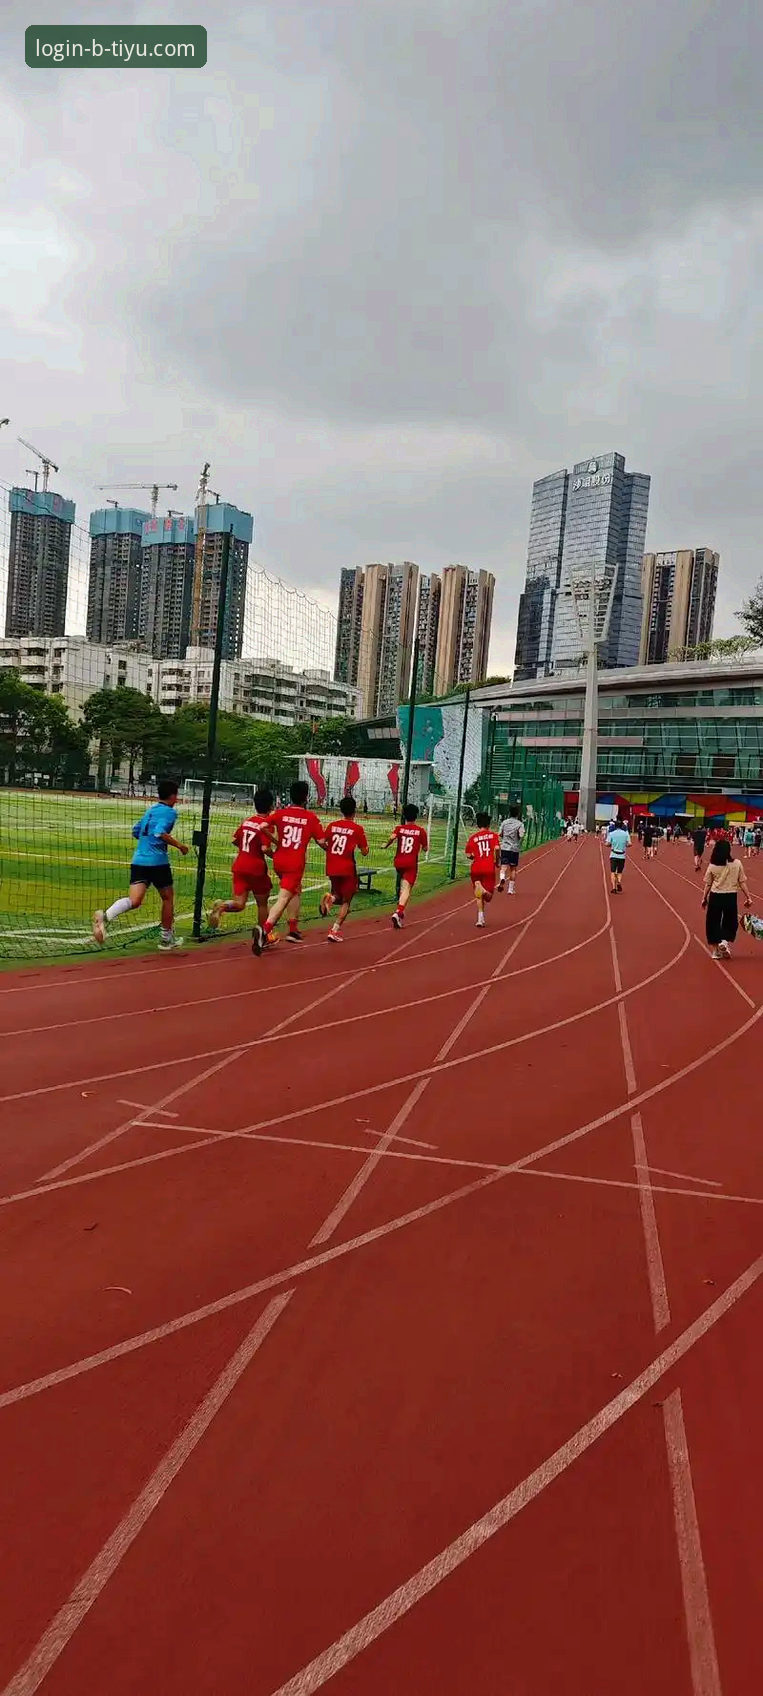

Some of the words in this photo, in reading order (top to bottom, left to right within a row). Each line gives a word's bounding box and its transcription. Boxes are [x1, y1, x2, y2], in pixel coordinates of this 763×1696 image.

[242, 829, 256, 852] 17
[281, 825, 303, 849] 34
[331, 834, 347, 855] 29
[400, 836, 414, 853] 18
[477, 841, 490, 857] 14
